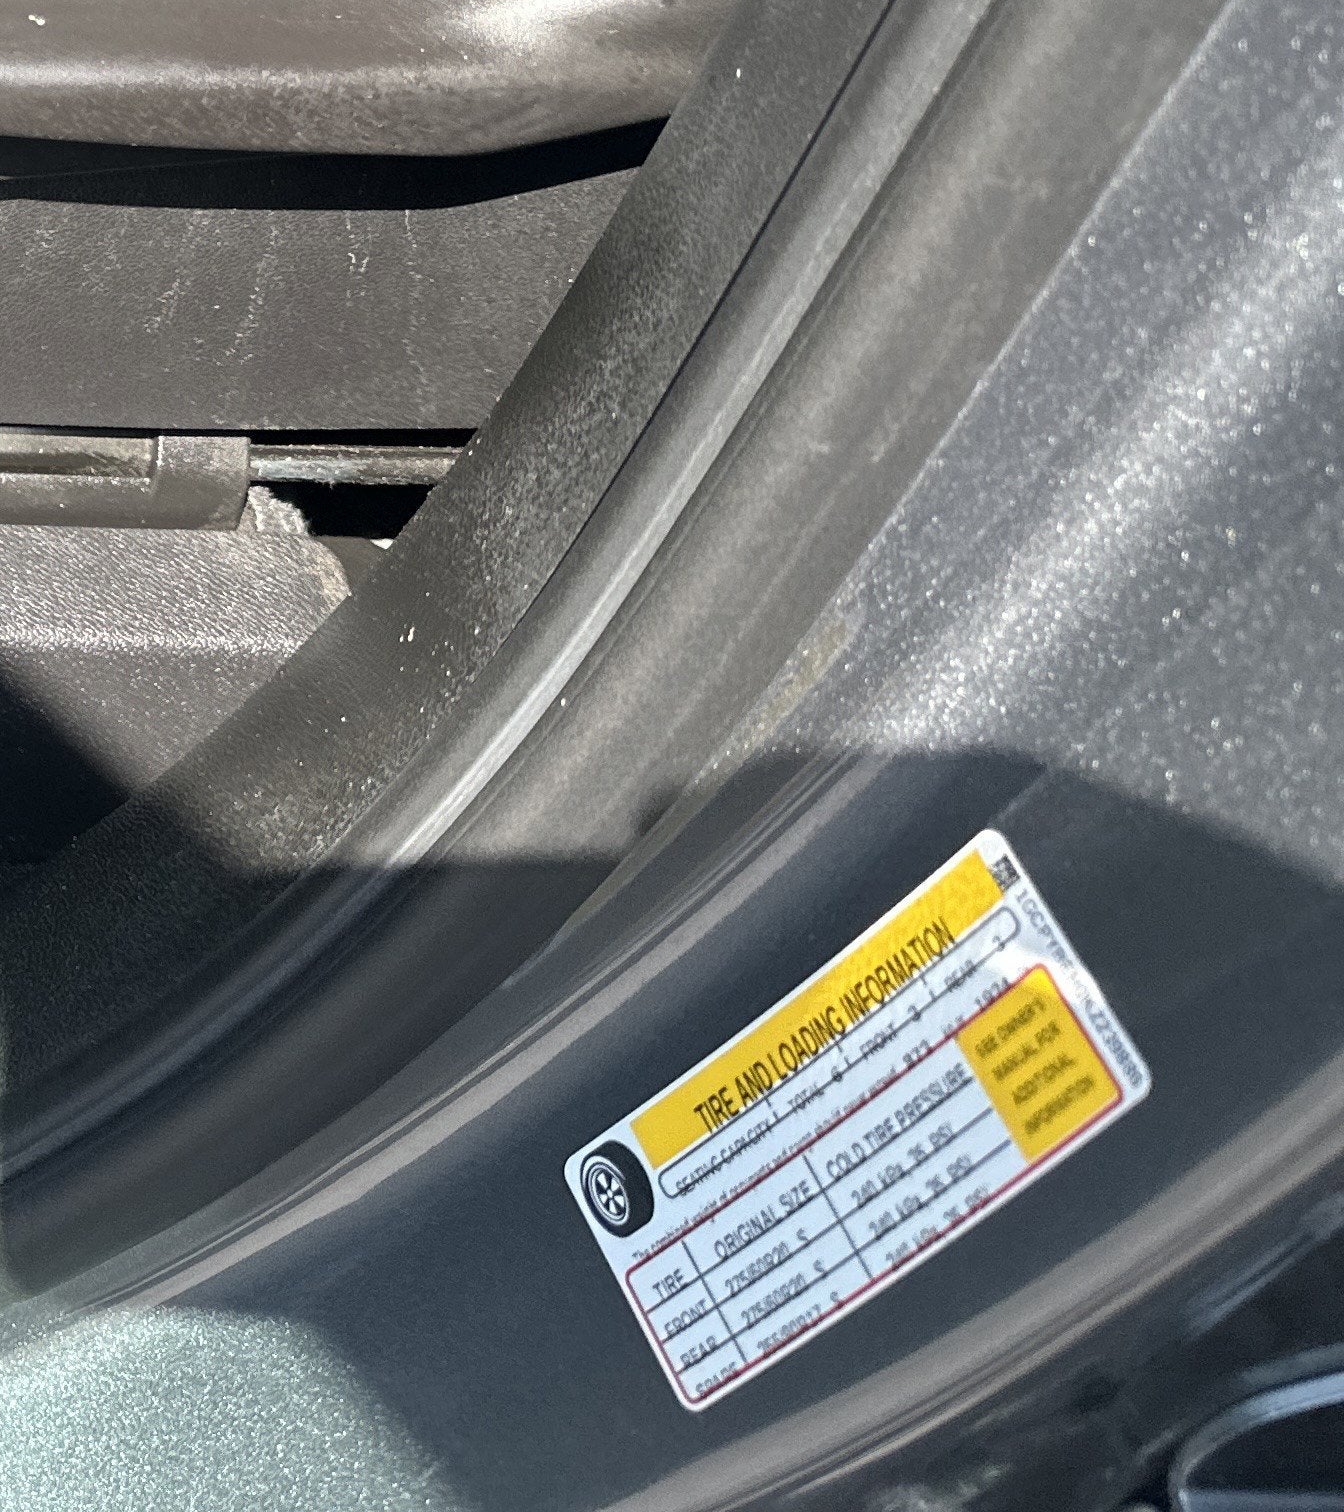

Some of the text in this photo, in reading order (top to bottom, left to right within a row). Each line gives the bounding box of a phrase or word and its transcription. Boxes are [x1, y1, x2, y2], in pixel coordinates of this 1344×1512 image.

[693, 914, 956, 1133] TIRE AND LOADING INFORMATION
[652, 1267, 687, 1300] TIRE
[712, 1203, 781, 1260] ORIGINAL
[778, 1178, 814, 1214] SIZE
[823, 1139, 868, 1181] COLD
[893, 1061, 970, 1128] PRESSURE
[663, 1298, 711, 1337] FRONT
[679, 1334, 719, 1369] REAR
